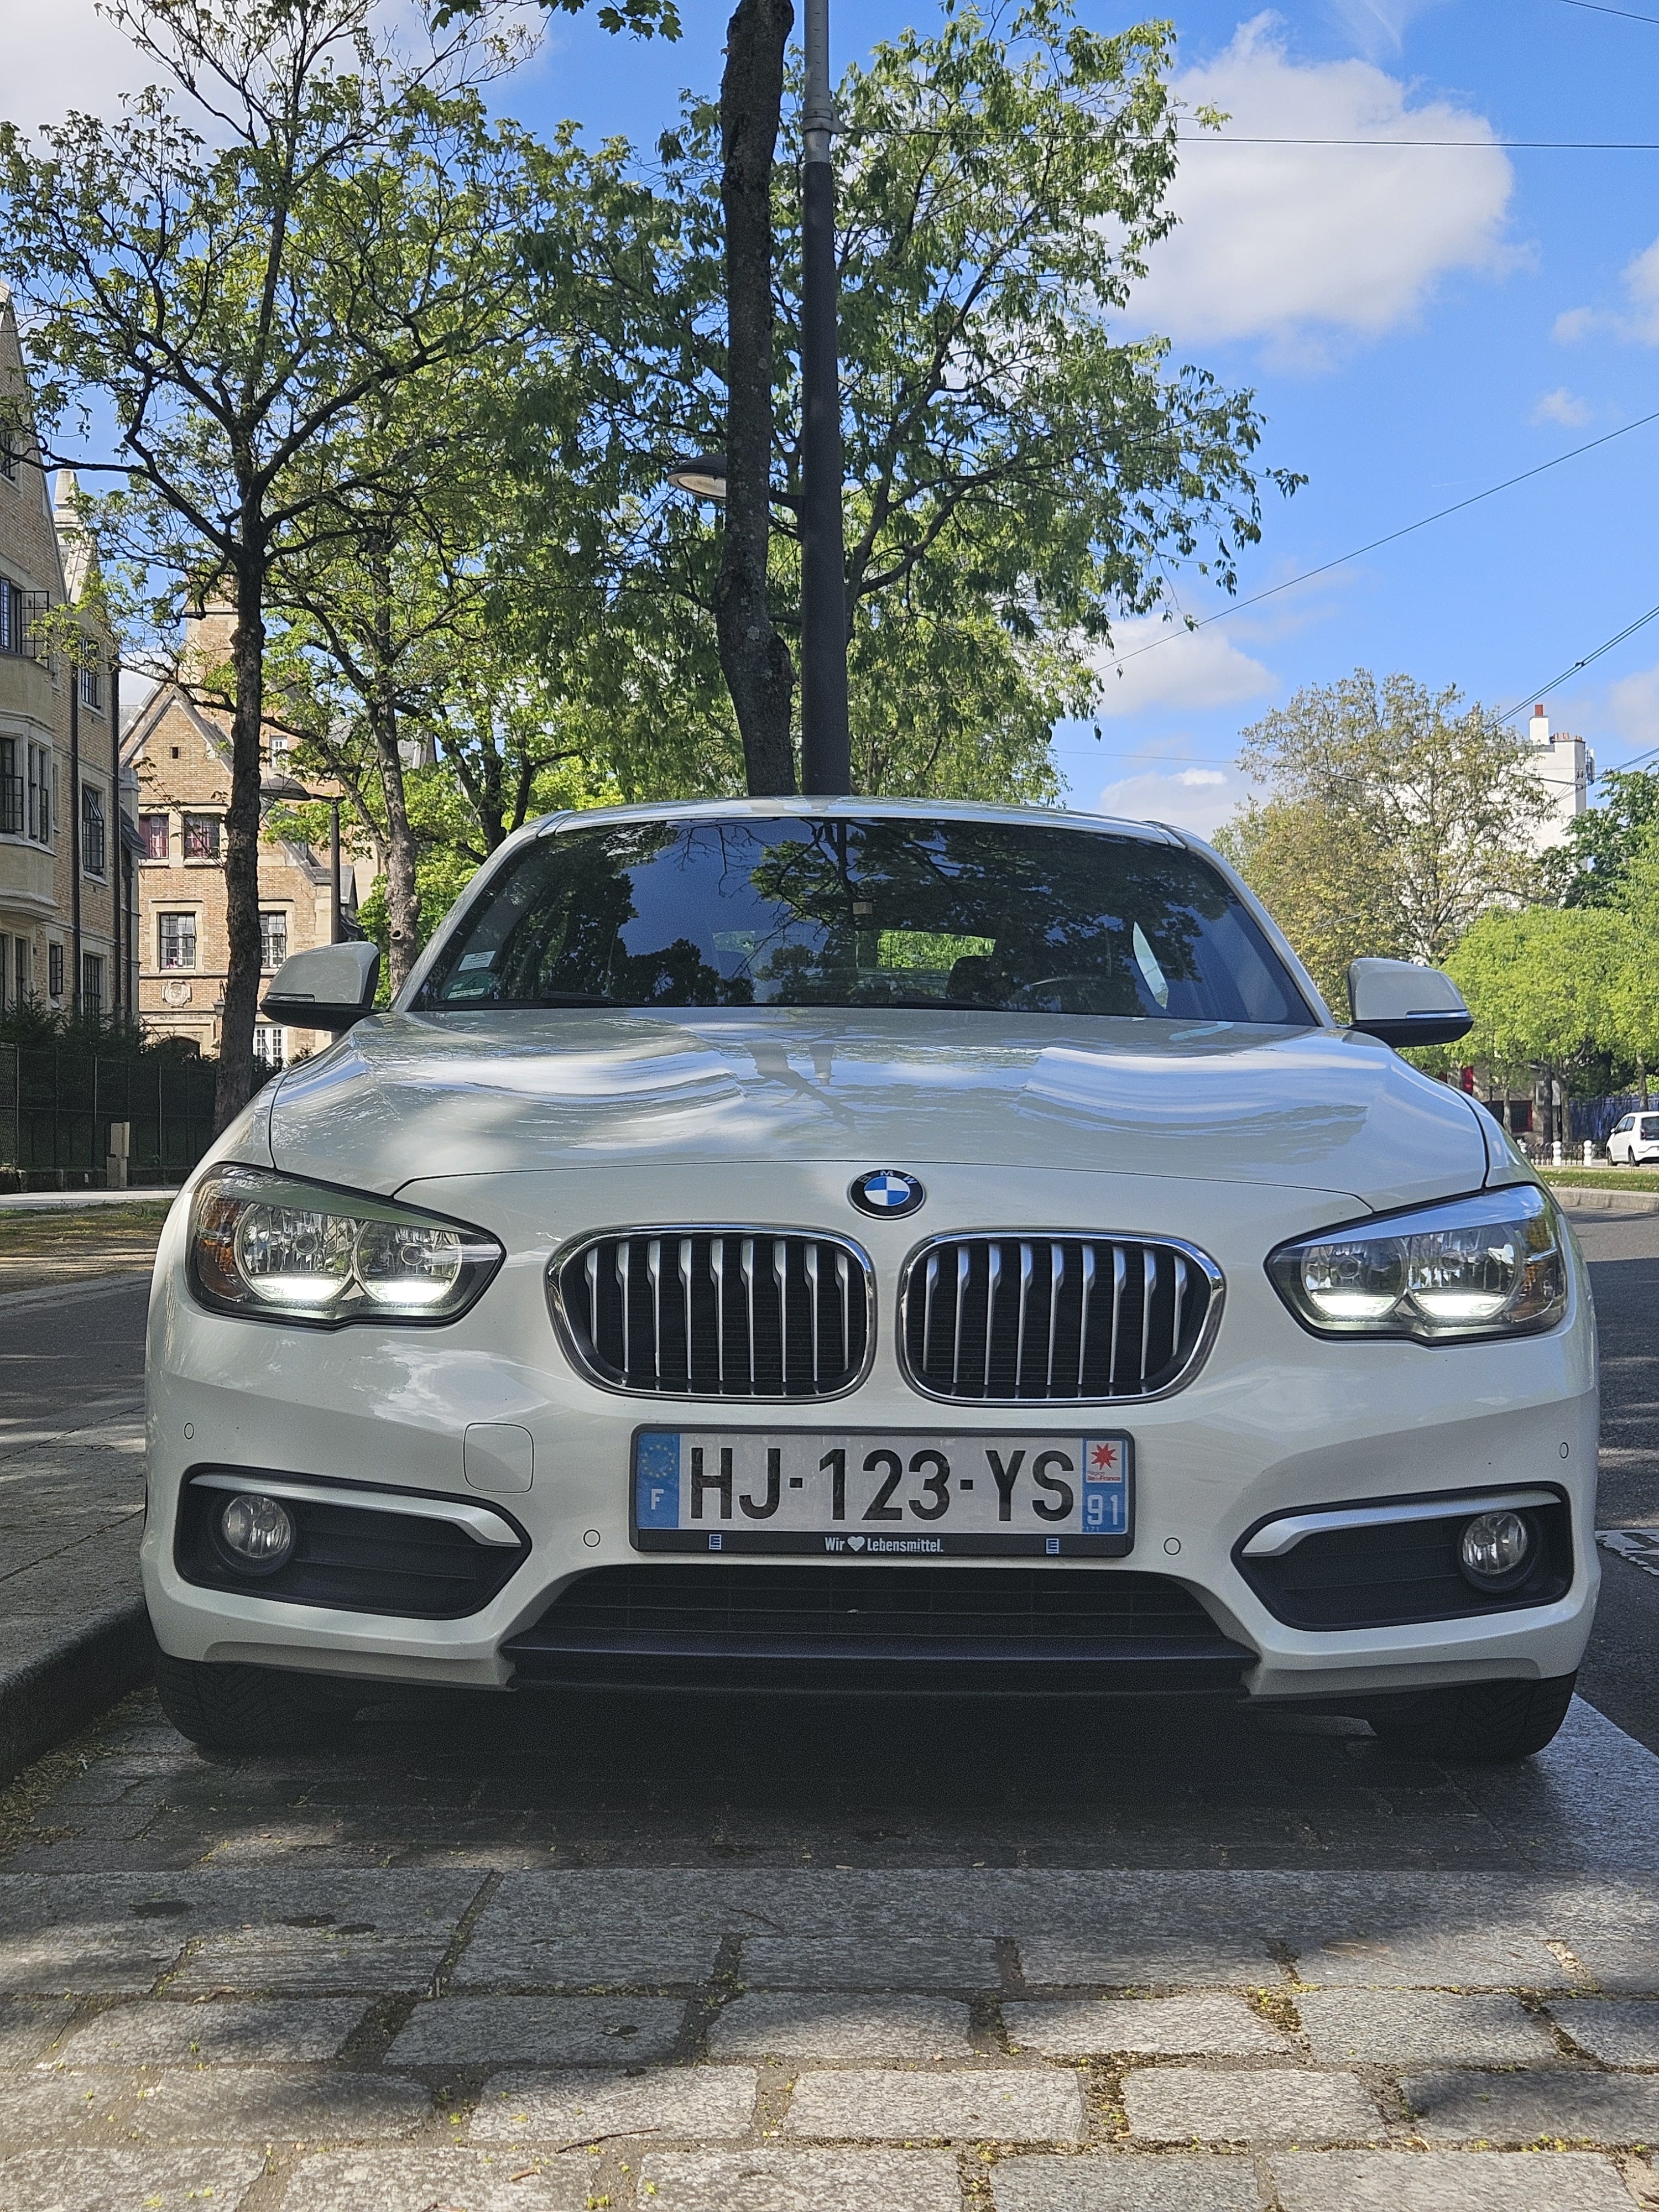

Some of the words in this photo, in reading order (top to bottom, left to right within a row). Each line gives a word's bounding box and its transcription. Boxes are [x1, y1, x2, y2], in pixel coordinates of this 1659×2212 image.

[858, 1170, 918, 1185] BMW
[691, 1447, 1074, 1522] HJ-123-YS
[651, 1489, 664, 1510] F
[1087, 1494, 1118, 1525] 91
[825, 1537, 845, 1551] Wir
